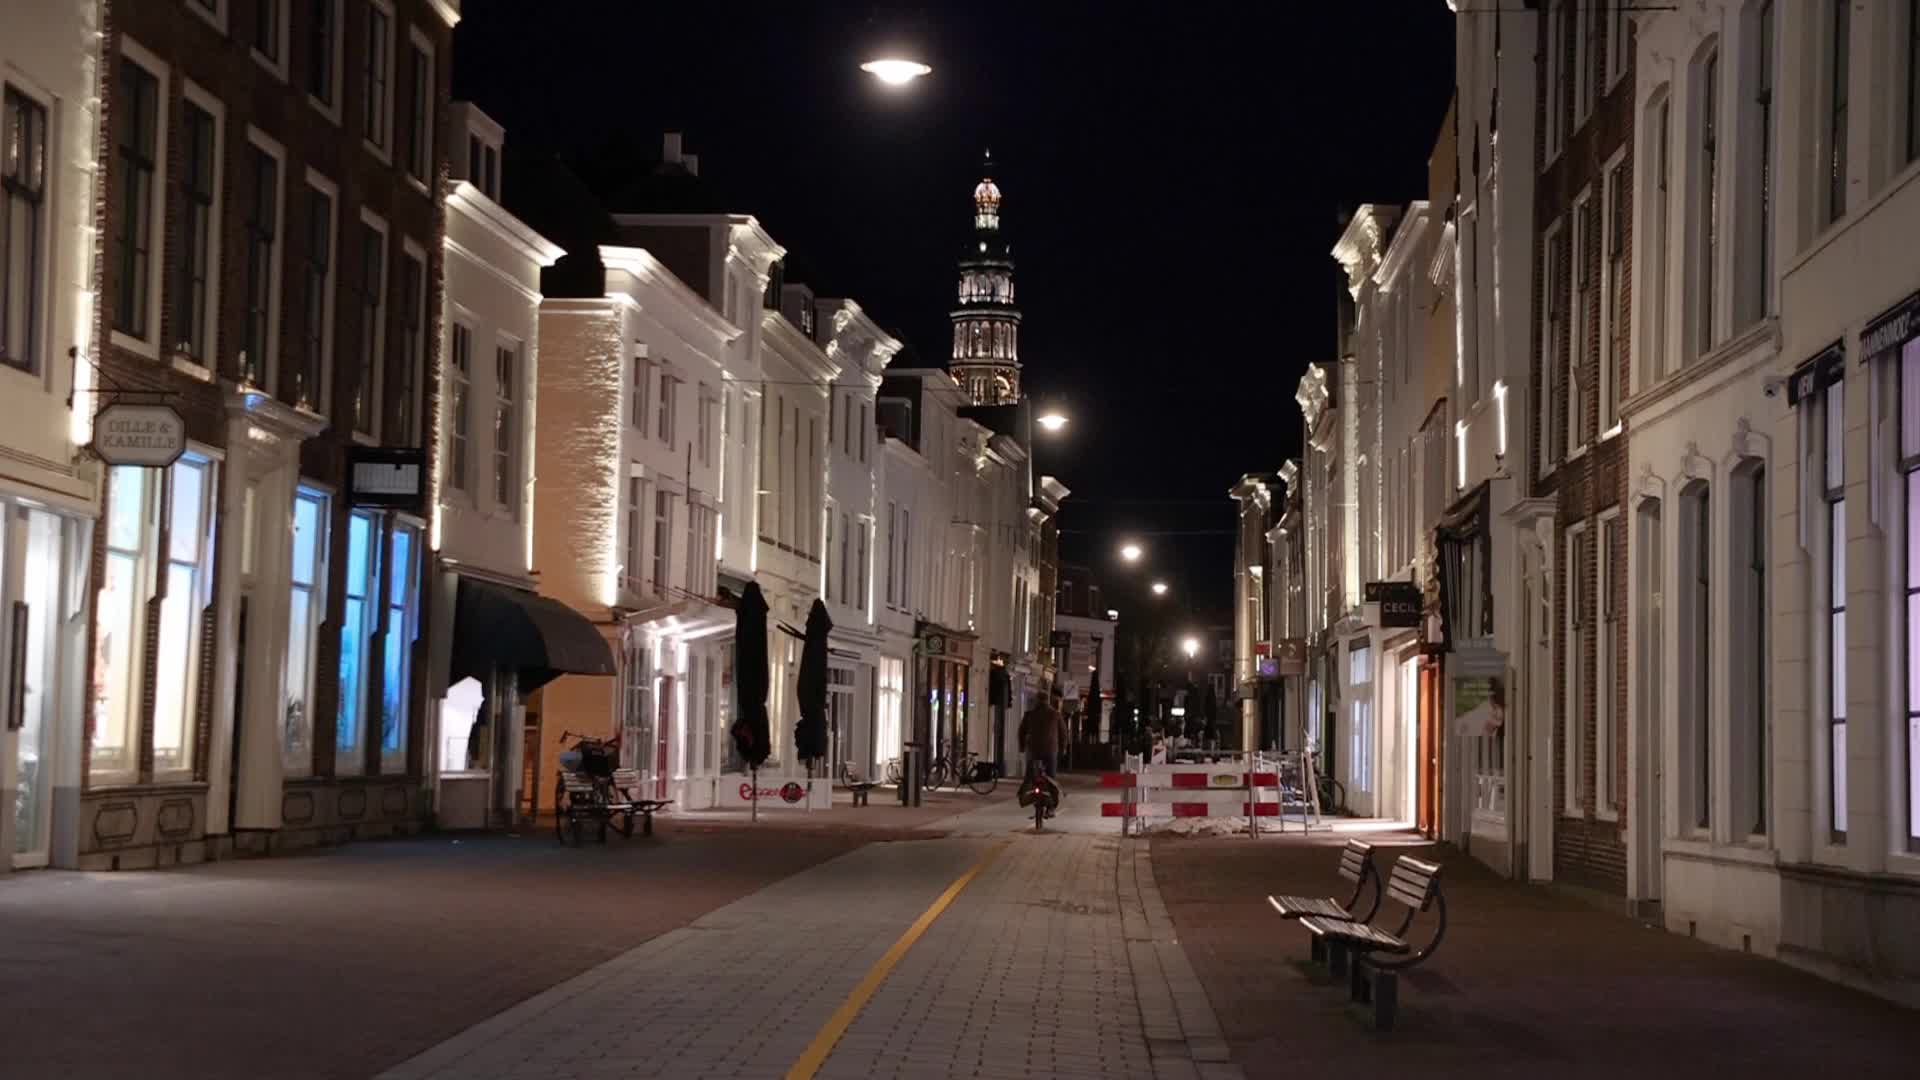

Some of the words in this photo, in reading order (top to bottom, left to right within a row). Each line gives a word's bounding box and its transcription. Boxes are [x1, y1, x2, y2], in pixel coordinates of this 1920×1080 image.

[109, 420, 156, 433] DILLE
[159, 423, 173, 434] &
[103, 434, 176, 449] KAMILLE
[1383, 602, 1418, 613] CECIL
